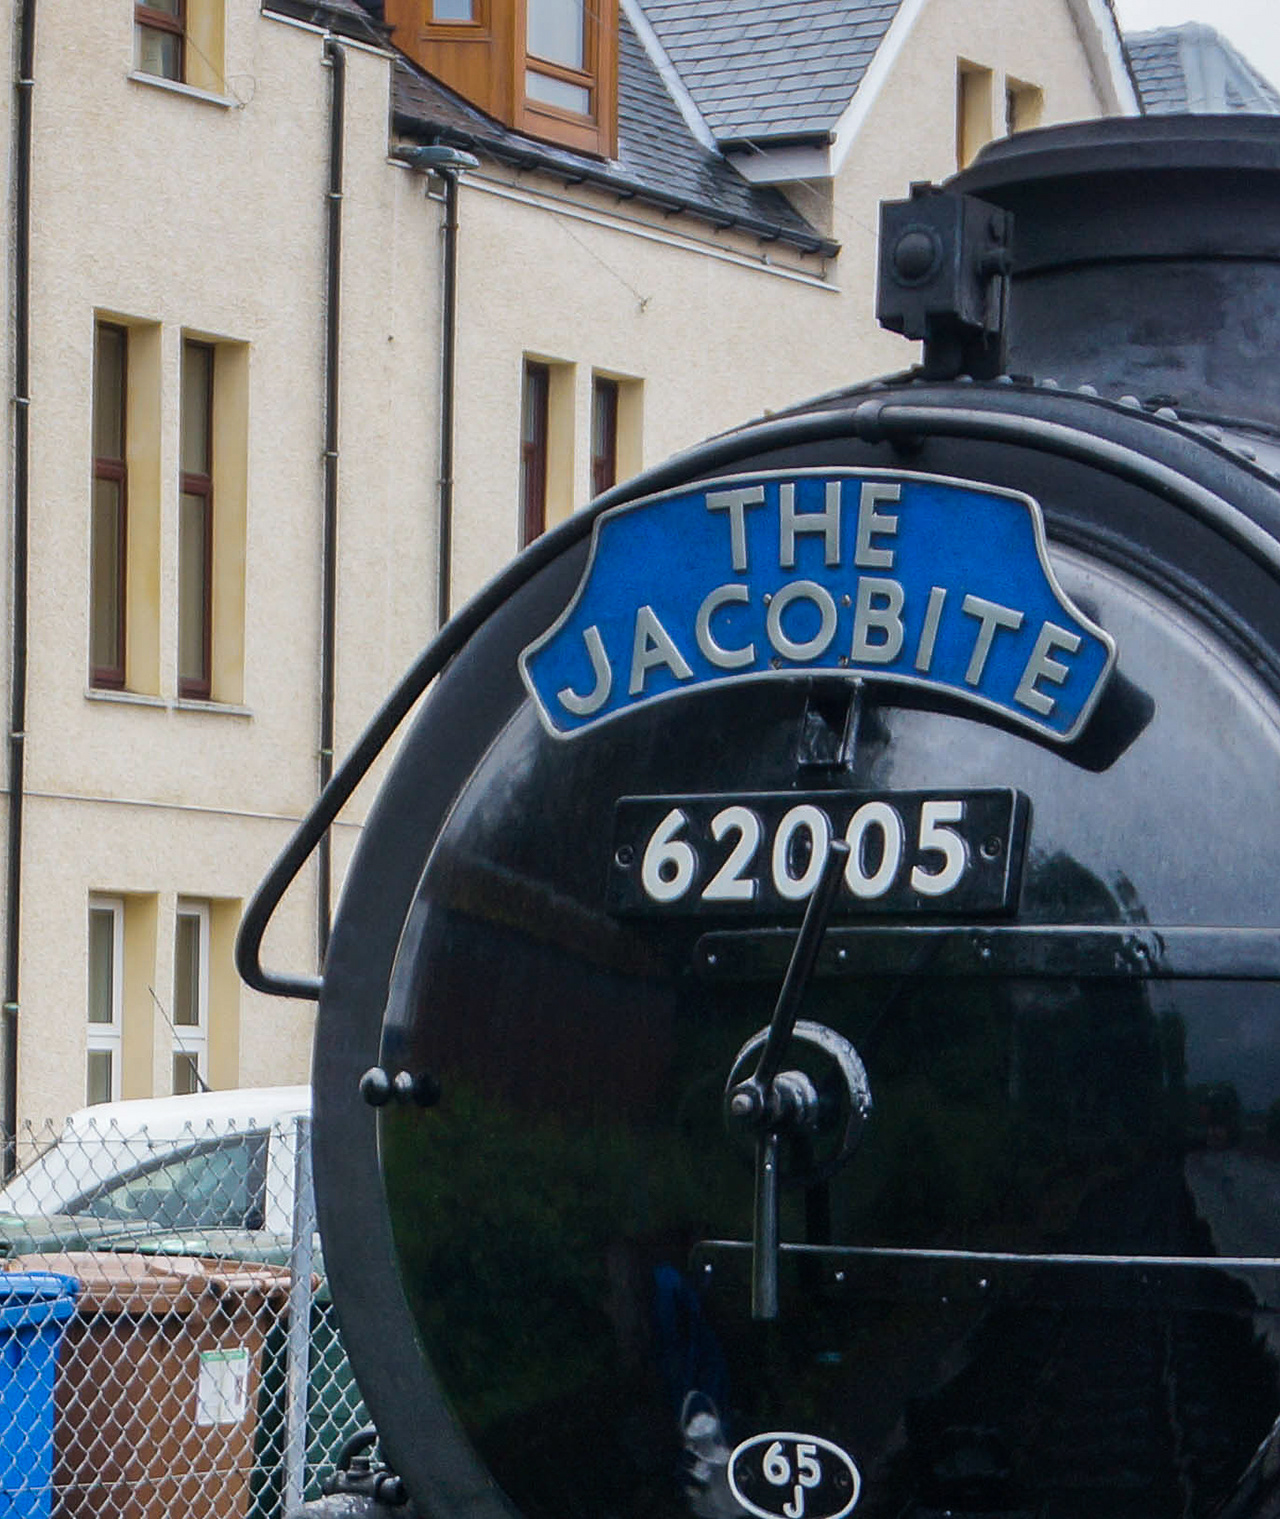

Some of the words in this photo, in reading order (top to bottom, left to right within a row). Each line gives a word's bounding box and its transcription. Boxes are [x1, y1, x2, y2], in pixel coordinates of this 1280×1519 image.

[706, 481, 901, 572] THE
[557, 576, 1081, 716] JACOBITE
[641, 800, 968, 900] 62005
[763, 1441, 821, 1488] 65
[783, 1485, 804, 1519] J
